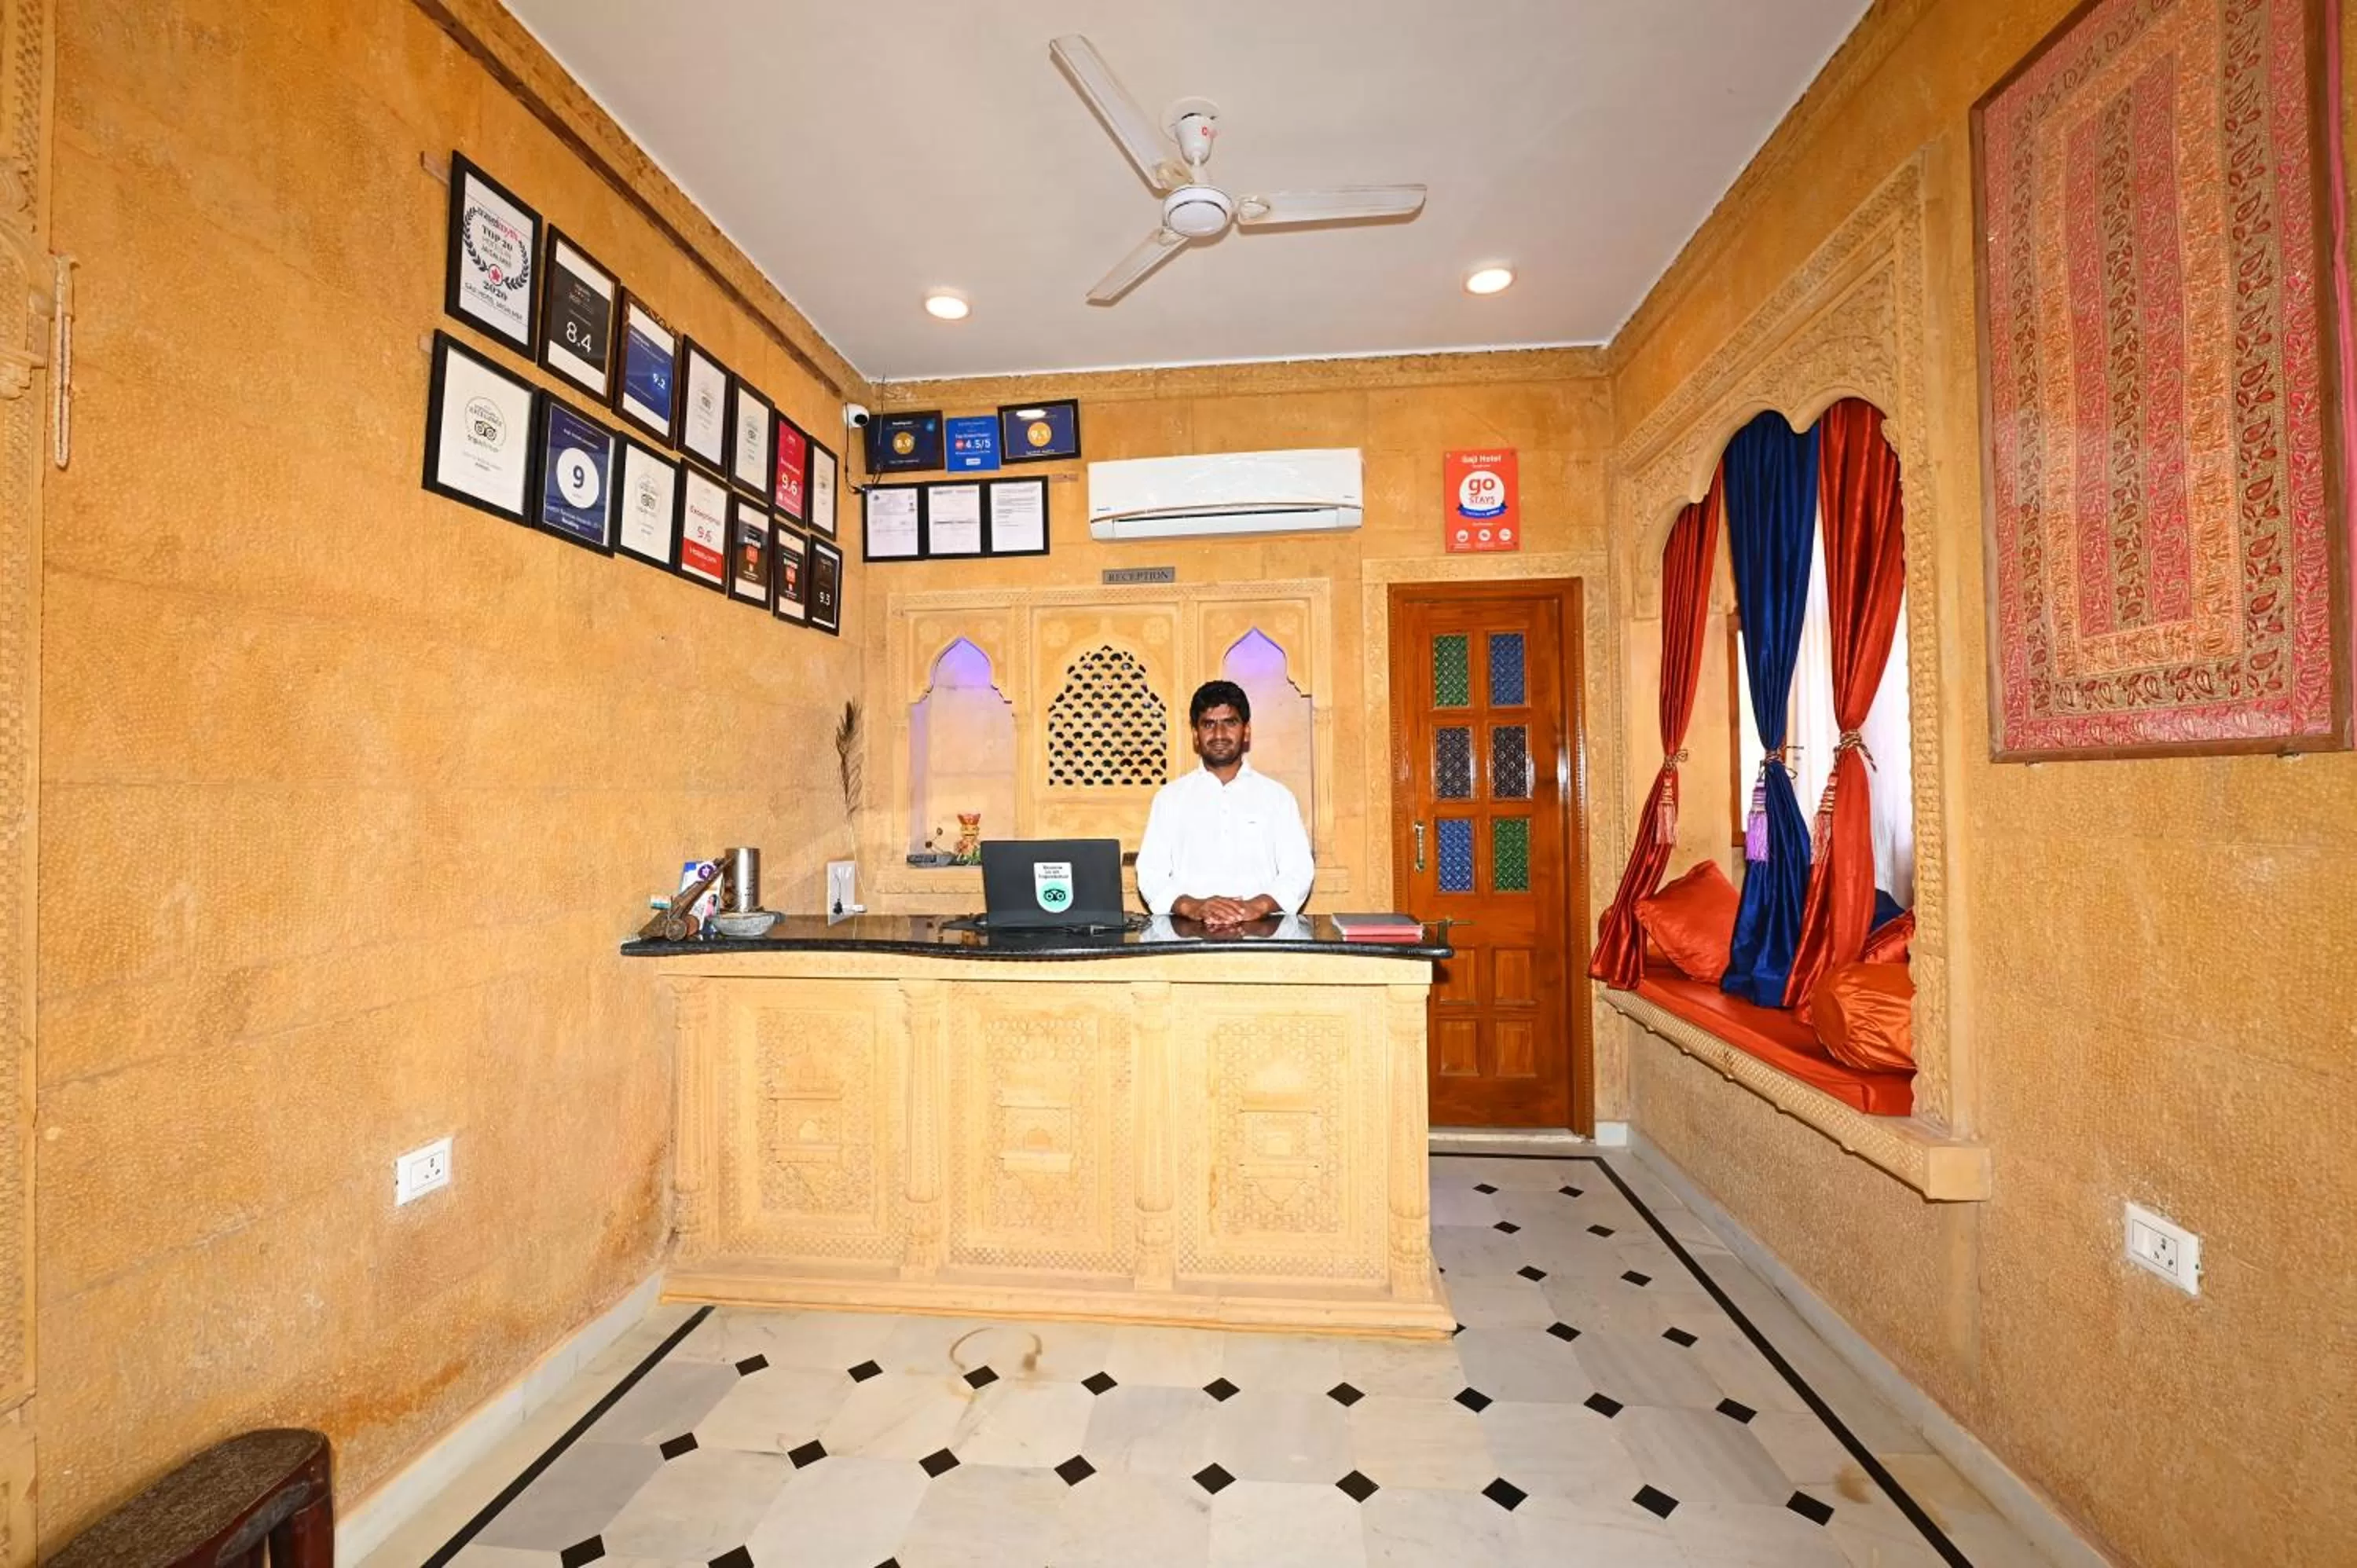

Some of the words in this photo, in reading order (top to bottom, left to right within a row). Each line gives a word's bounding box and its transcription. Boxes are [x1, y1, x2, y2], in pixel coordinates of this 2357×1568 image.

[482, 224, 500, 242] TOP
[502, 239, 513, 251] 20
[566, 321, 592, 353] 8.4
[572, 464, 585, 489] 9
[1468, 478, 1495, 496] go
[1468, 495, 1495, 504] STAYS
[1108, 570, 1169, 582] RECEPTION
